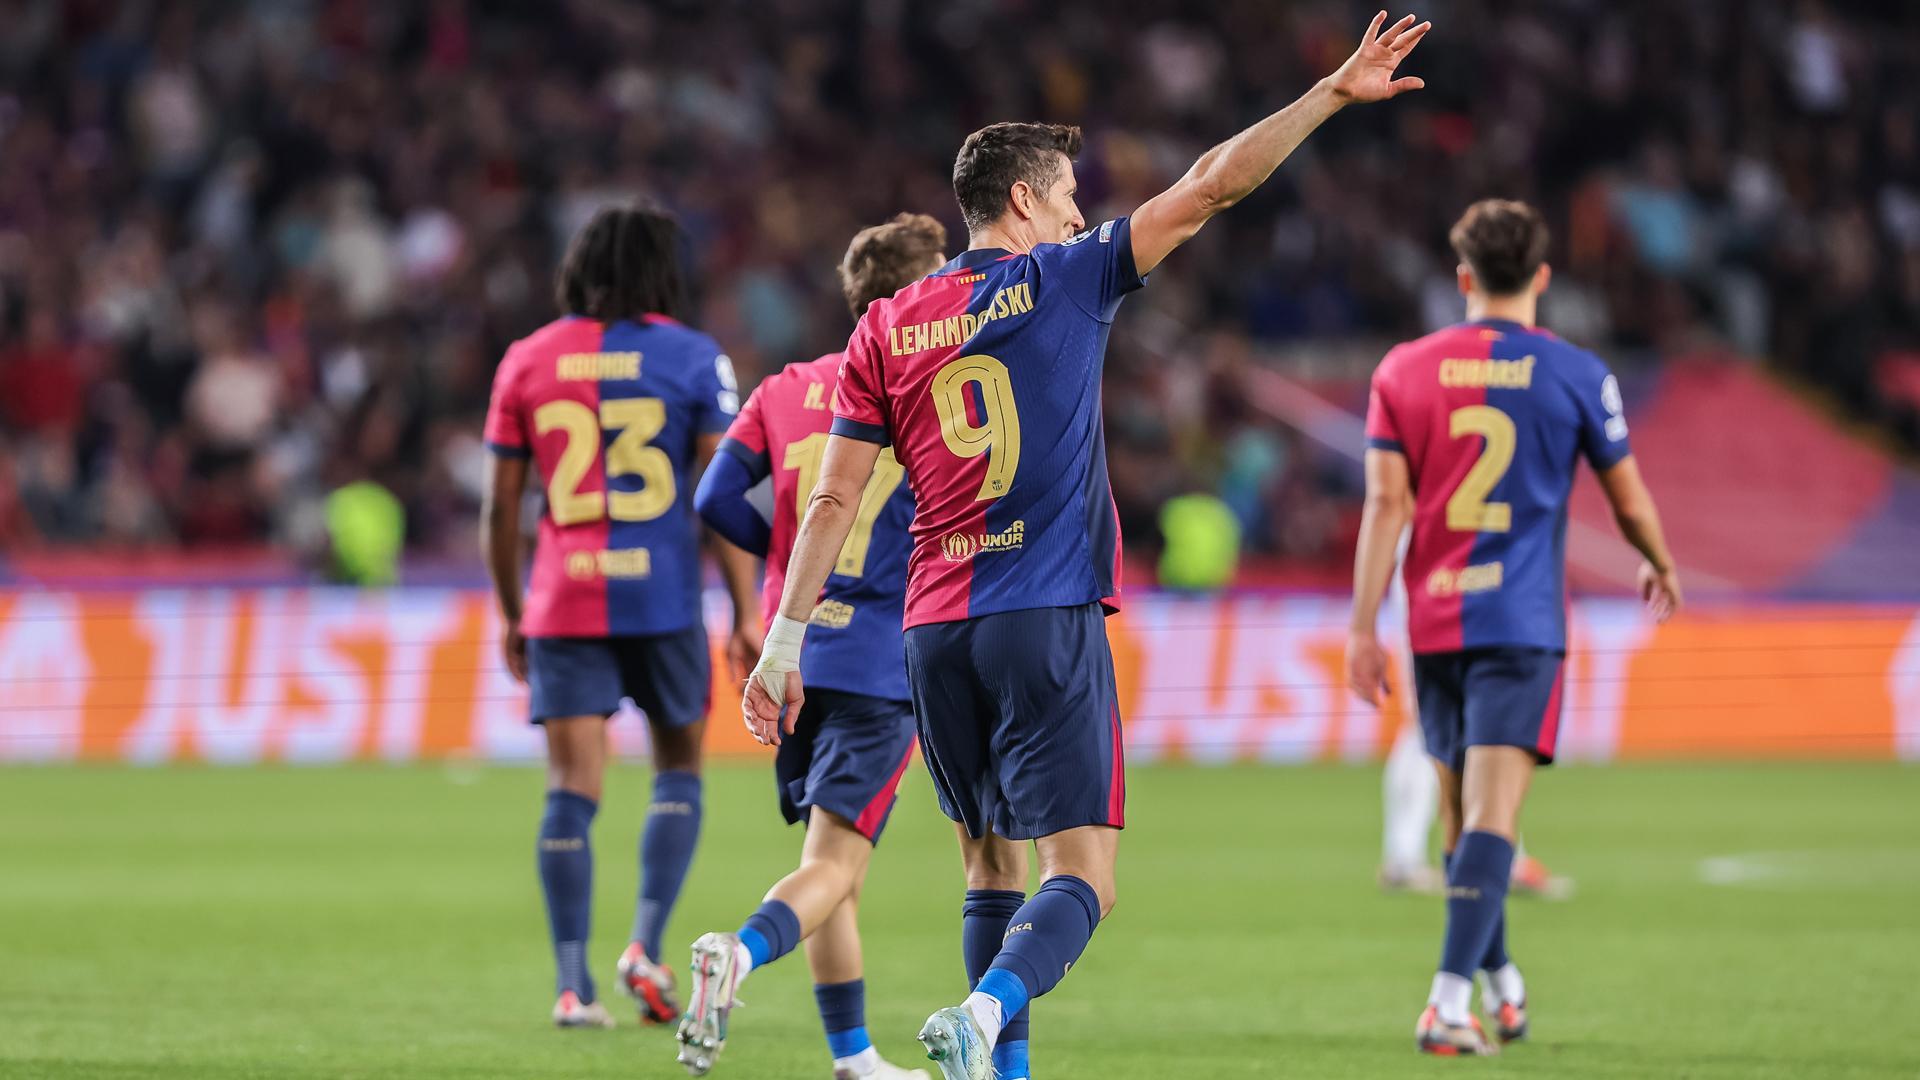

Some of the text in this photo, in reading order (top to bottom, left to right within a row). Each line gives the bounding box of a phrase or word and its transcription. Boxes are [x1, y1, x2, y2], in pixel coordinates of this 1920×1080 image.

[533, 398, 676, 526] 23
[930, 354, 1020, 502] 9
[1445, 404, 1516, 532] 2
[120, 588, 470, 762] JUST
